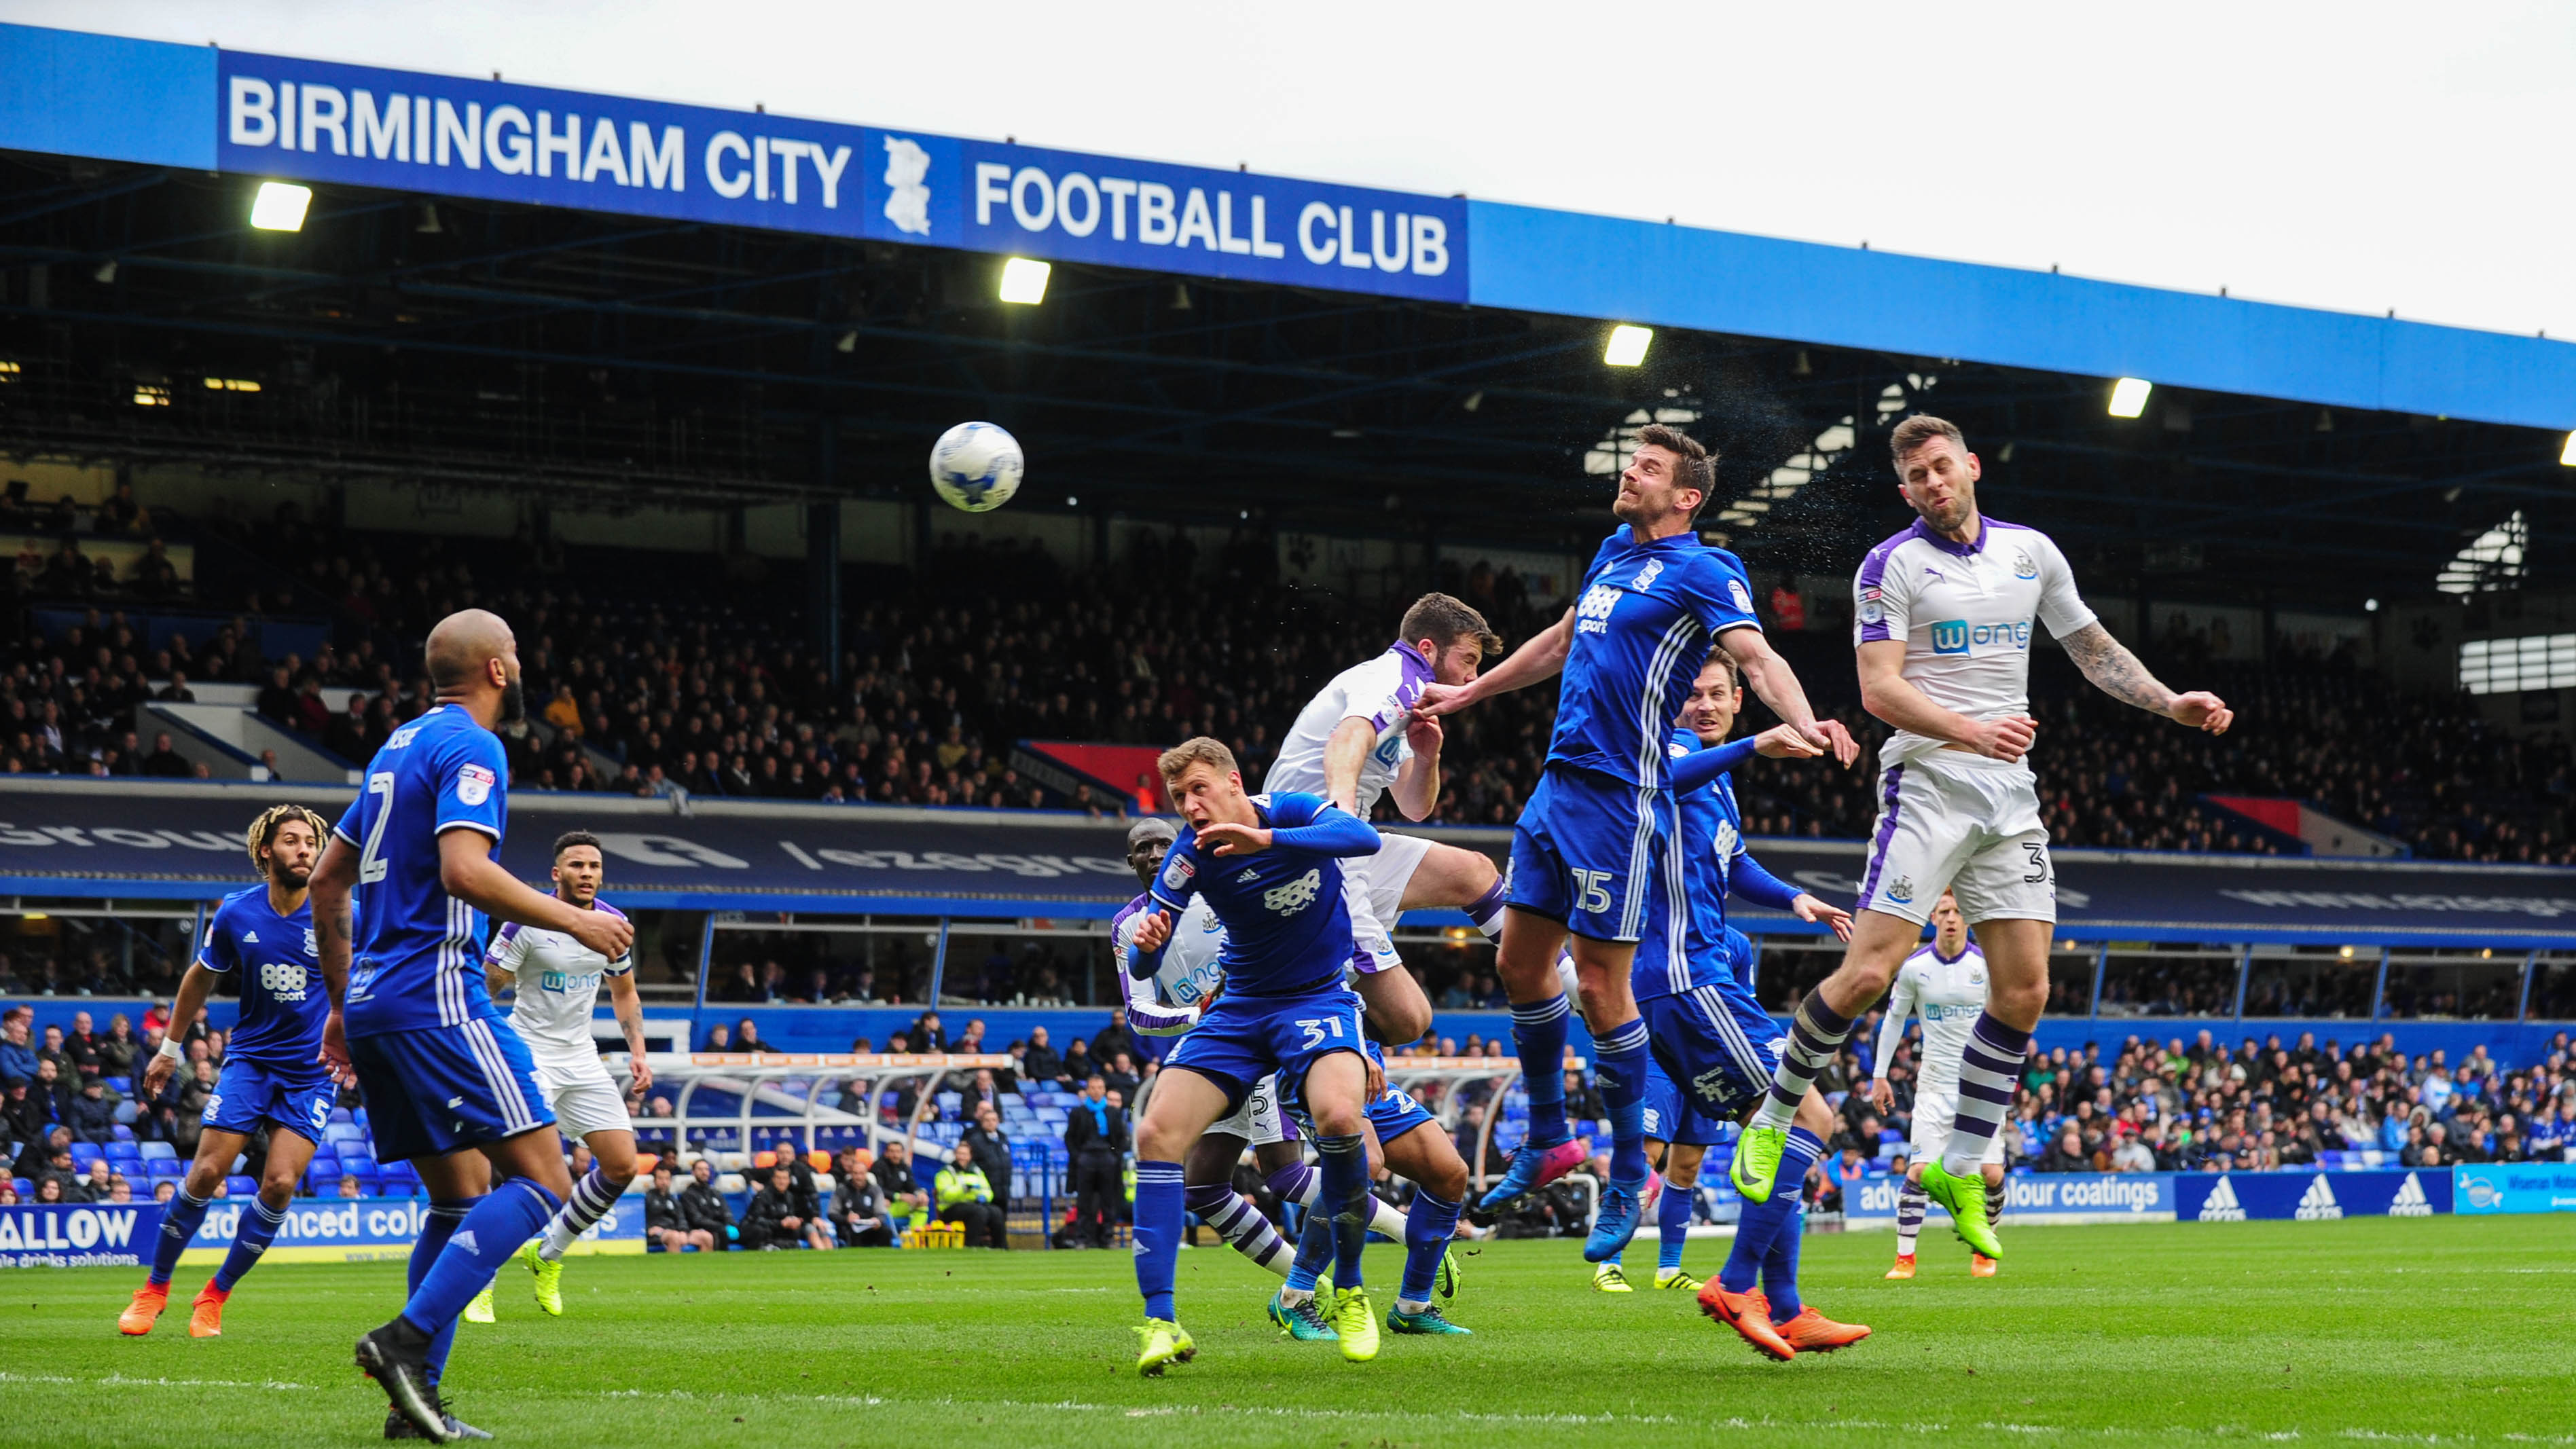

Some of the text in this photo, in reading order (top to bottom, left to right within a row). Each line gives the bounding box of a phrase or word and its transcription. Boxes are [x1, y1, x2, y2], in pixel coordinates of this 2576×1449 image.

[229, 75, 1450, 276] BIRMINGHAM CITY FOOTBALL CLUB
[1578, 584, 1623, 619] 888
[1578, 619, 1608, 634] sport
[0, 822, 249, 852] Grou
[360, 771, 395, 885] 2
[2022, 843, 2054, 885] 3
[1572, 867, 1613, 914] 15
[261, 964, 307, 990] 888
[274, 991, 307, 1003] sport
[1294, 1016, 1344, 1050] 31
[310, 1097, 329, 1129] 5
[2061, 1173, 2159, 1212] coatings
[200, 1203, 359, 1239] adnced
[18, 1251, 67, 1268] drinks
[69, 1252, 139, 1267] solutions
